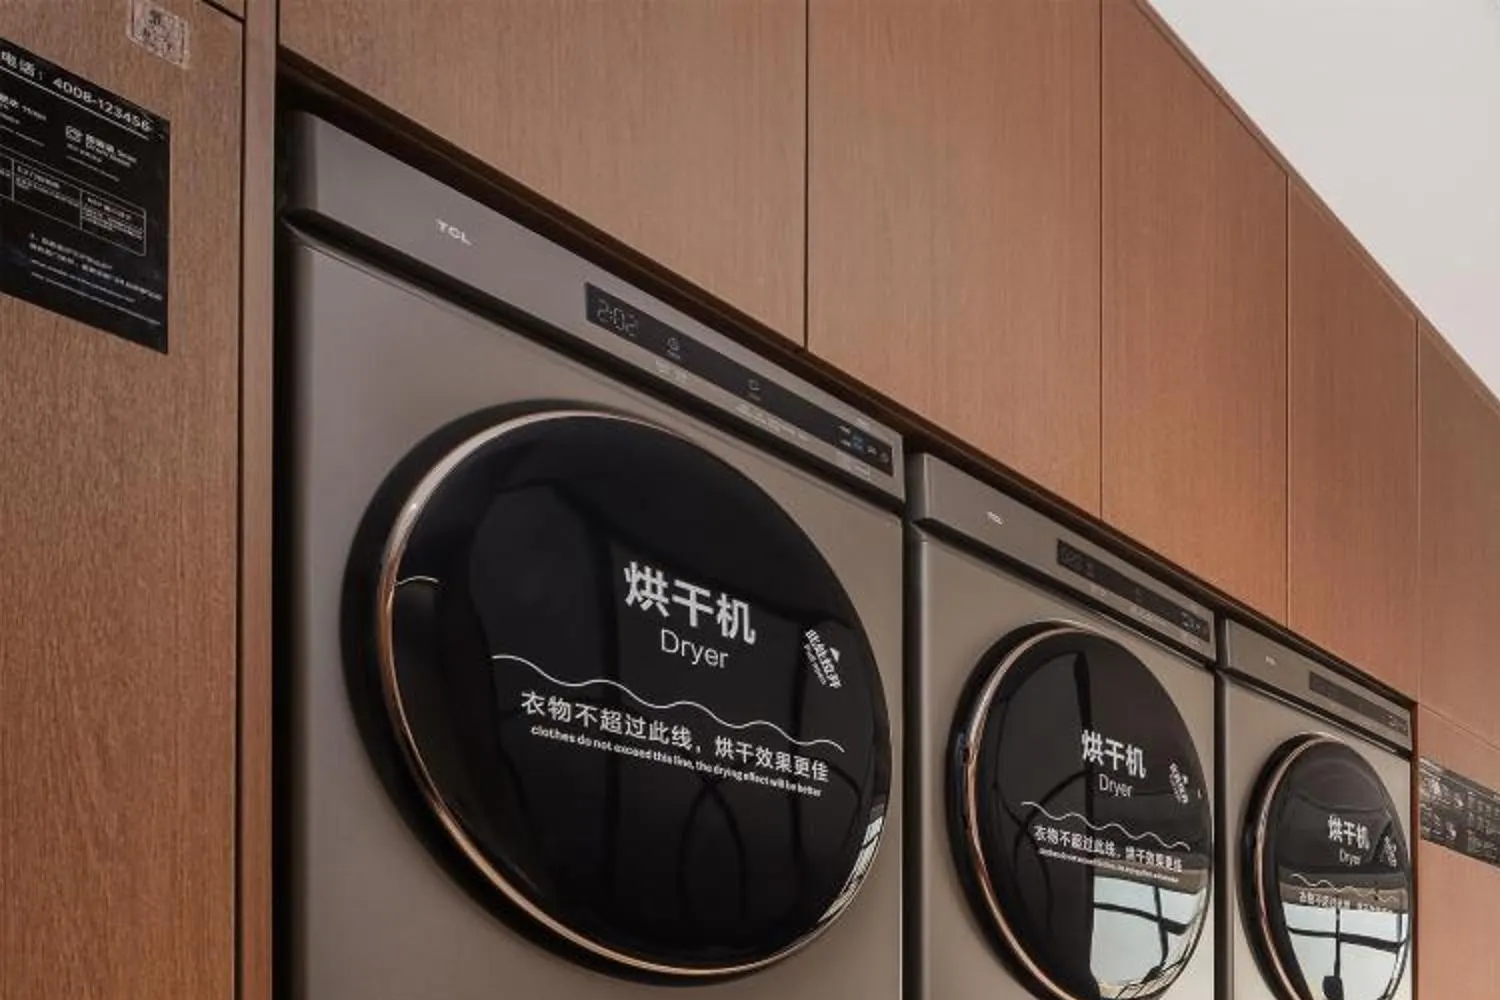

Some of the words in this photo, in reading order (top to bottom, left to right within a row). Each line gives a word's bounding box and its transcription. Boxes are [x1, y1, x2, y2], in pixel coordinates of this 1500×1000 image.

[435, 219, 472, 246] TCL
[624, 561, 757, 645] 烘干机
[661, 628, 729, 668] Dryer
[531, 725, 576, 743] clothes
[577, 734, 593, 747] do
[594, 739, 612, 751] not
[653, 752, 672, 764] this
[1081, 729, 1146, 779] 烘干机
[1099, 773, 1134, 798] Dryer
[1328, 815, 1370, 850] 烘干机
